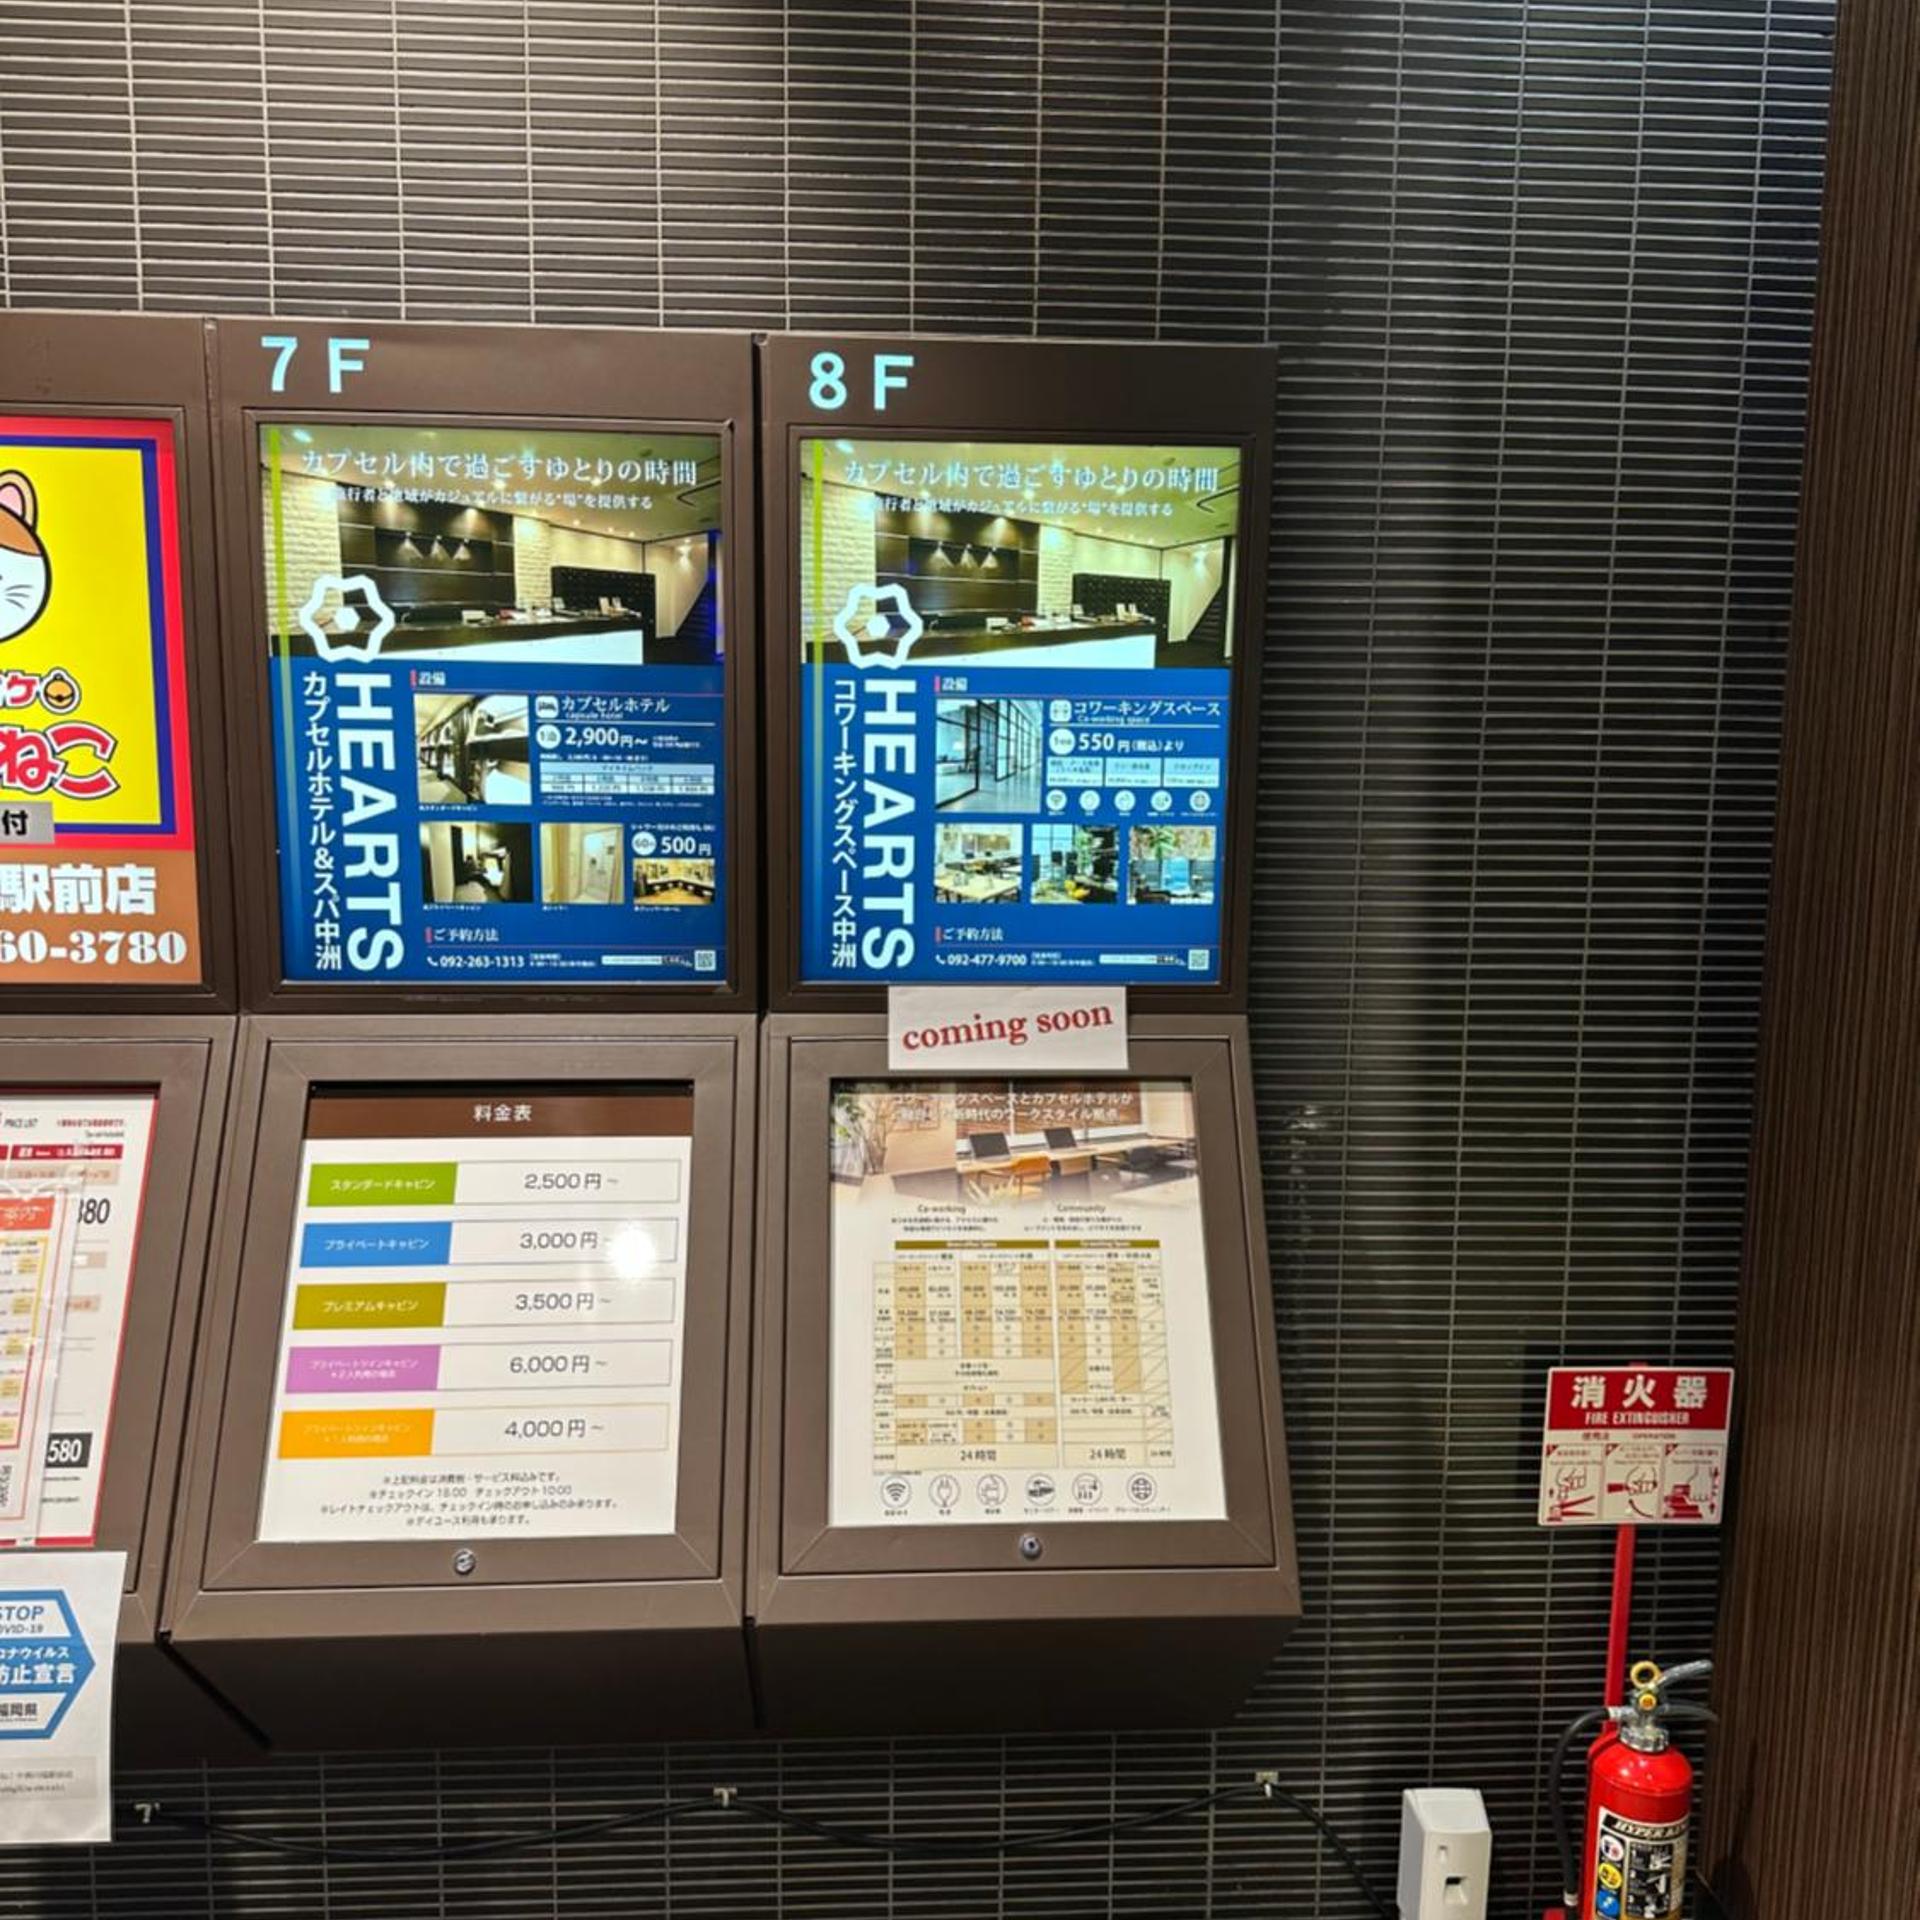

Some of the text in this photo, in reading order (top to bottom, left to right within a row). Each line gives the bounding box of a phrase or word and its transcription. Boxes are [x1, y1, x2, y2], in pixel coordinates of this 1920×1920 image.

[301, 450, 698, 487] カプセル内で過ごすゆとりの時間
[843, 459, 1219, 492] カプセル内で過ごすゆとりの時間
[941, 677, 968, 692] 設備
[561, 695, 671, 714] カプセルホテル
[1073, 701, 1221, 717] コワーキングスペース
[335, 672, 405, 972] HEARTS
[831, 679, 858, 969] コワーキングスペース中洲
[862, 678, 917, 970] HEARTS
[433, 927, 500, 943] ご予約方法
[942, 926, 1004, 942] ご予約方法
[439, 954, 525, 970] 092-263-1313
[946, 953, 1028, 967] 092-477-9700
[902, 1004, 1114, 1052] coming soon
[472, 1103, 533, 1123] 料金表
[1571, 1374, 1708, 1409] 消火器
[1585, 1411, 1608, 1425] FIRE
[47, 1439, 82, 1463] 580
